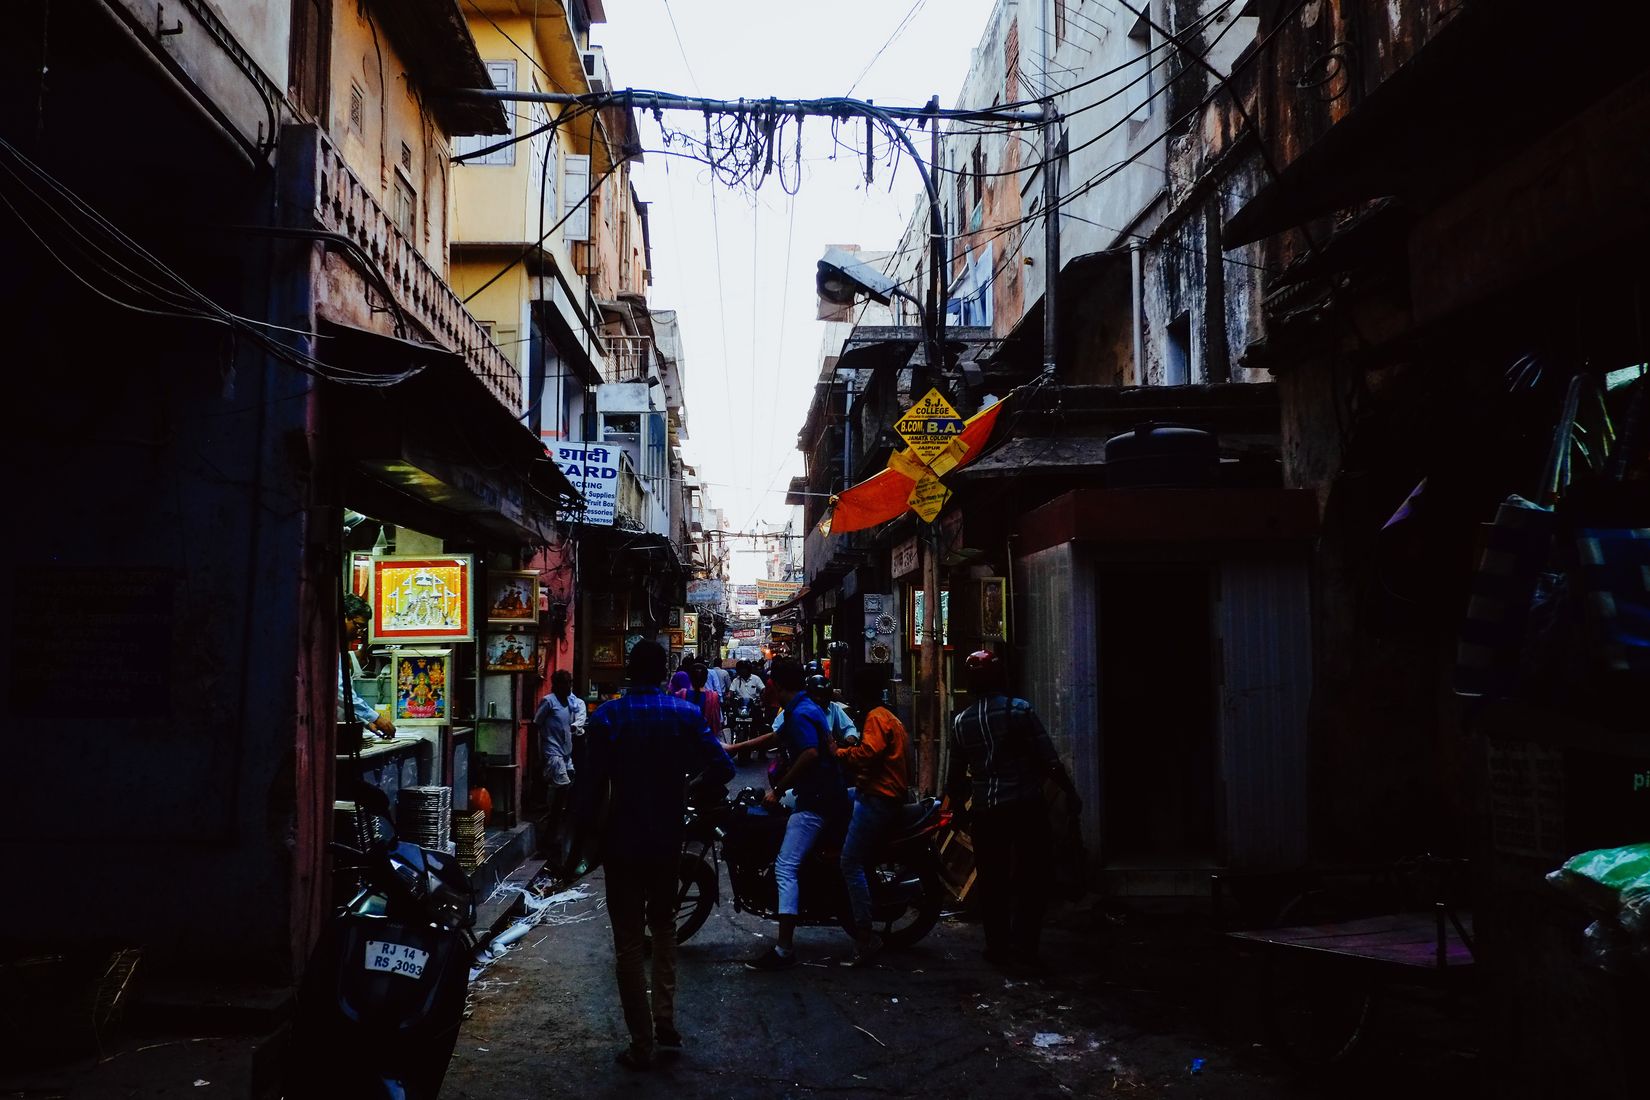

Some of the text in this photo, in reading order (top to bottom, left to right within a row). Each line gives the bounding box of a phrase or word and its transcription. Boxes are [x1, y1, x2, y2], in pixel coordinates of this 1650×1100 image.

[924, 398, 943, 407] S.J.
[915, 407, 949, 415] COLLEGE
[926, 421, 961, 433] B.A.
[559, 448, 610, 463] शादी
[558, 463, 617, 479] ARD
[571, 480, 603, 490] ACKING
[588, 490, 615, 499] Supplies
[381, 943, 416, 960] RJ 14
[374, 955, 423, 976] RS 3093
